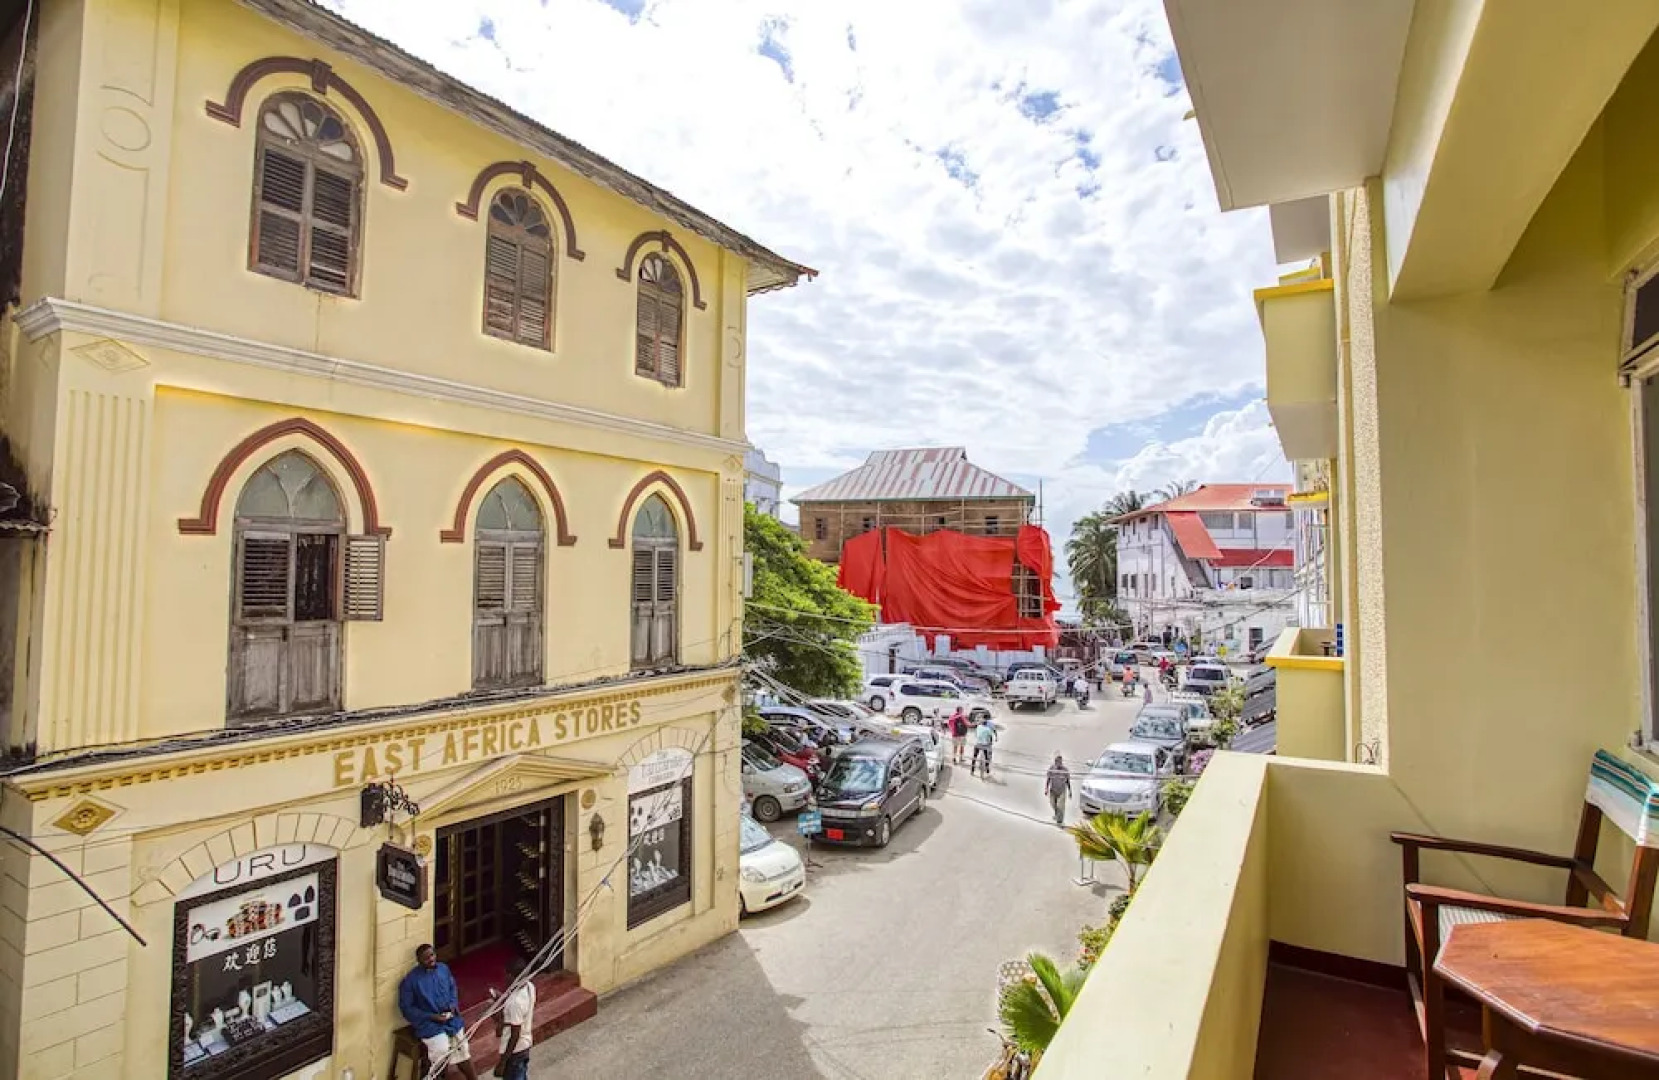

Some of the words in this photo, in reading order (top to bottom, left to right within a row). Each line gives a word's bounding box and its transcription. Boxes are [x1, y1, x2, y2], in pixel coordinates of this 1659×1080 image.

[332, 738, 425, 787] EAST
[442, 718, 541, 765] AFRICA
[554, 700, 642, 741] STORES
[213, 843, 307, 885] URU
